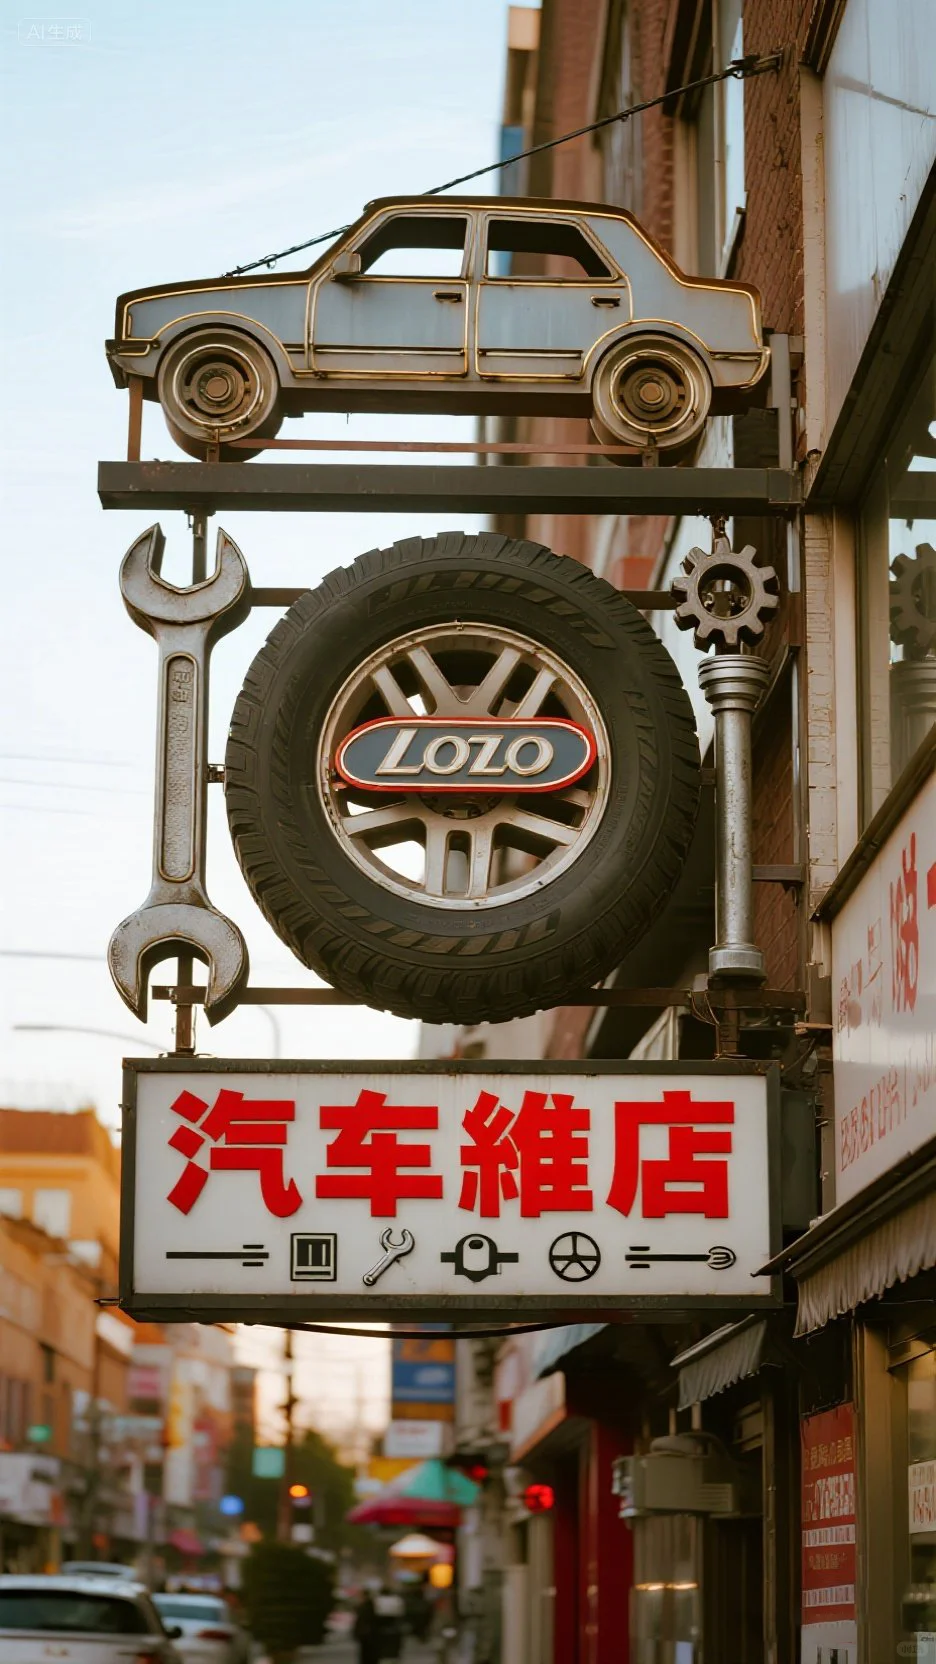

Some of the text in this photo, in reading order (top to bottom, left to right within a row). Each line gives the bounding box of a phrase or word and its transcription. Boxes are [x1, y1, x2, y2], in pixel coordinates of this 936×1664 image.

[374, 728, 554, 777] LOZO
[166, 1088, 735, 1219] 汽车維店
